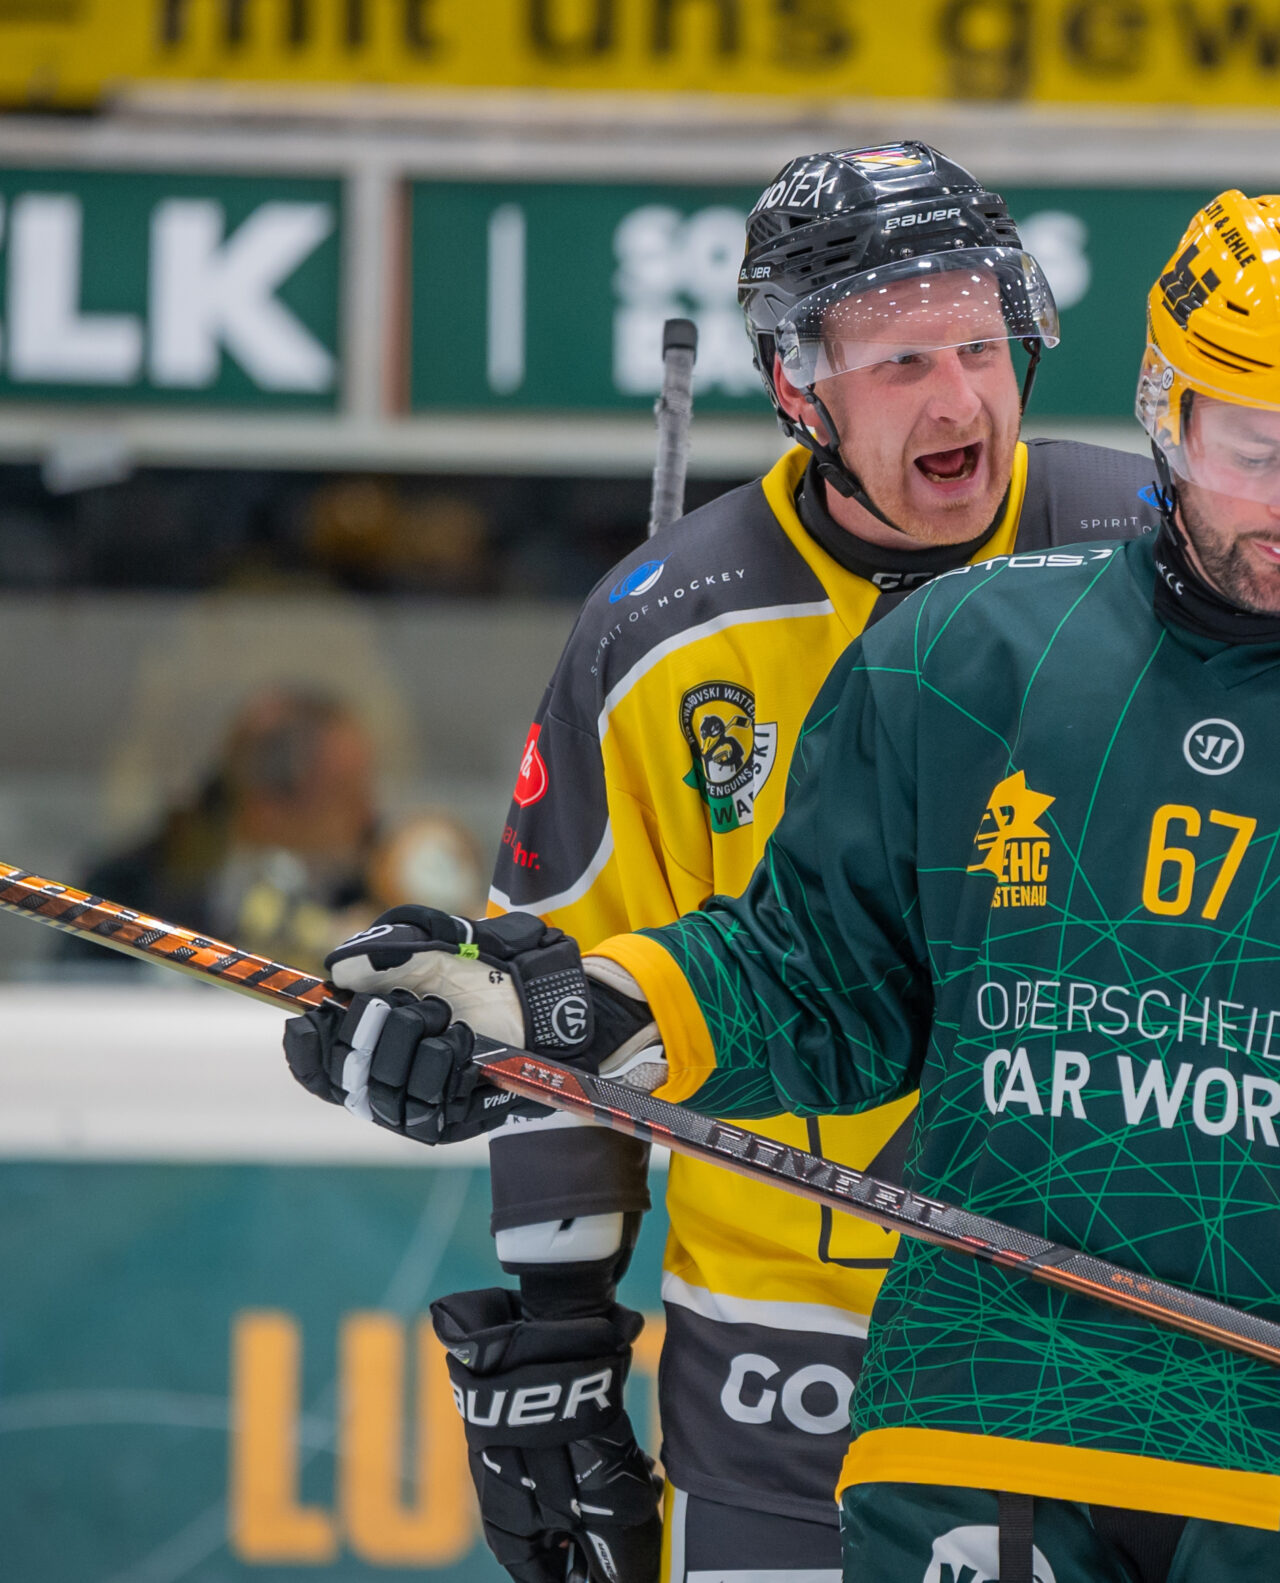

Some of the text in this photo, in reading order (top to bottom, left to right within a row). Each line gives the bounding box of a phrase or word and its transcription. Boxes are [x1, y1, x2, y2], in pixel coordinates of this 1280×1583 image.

[525, 0, 860, 75] uns
[884, 207, 961, 231] BAUER
[1221, 227, 1256, 268] JEHLE
[0, 190, 337, 395] LK
[740, 266, 771, 280] BUER
[1080, 517, 1138, 529] SPIRIT
[628, 605, 649, 623] OF
[658, 569, 745, 608] HOCKEY
[706, 768, 752, 797] PENGUINS
[1142, 803, 1257, 920] 67
[991, 885, 1047, 908] STENAU
[983, 1047, 1091, 1120] CAR
